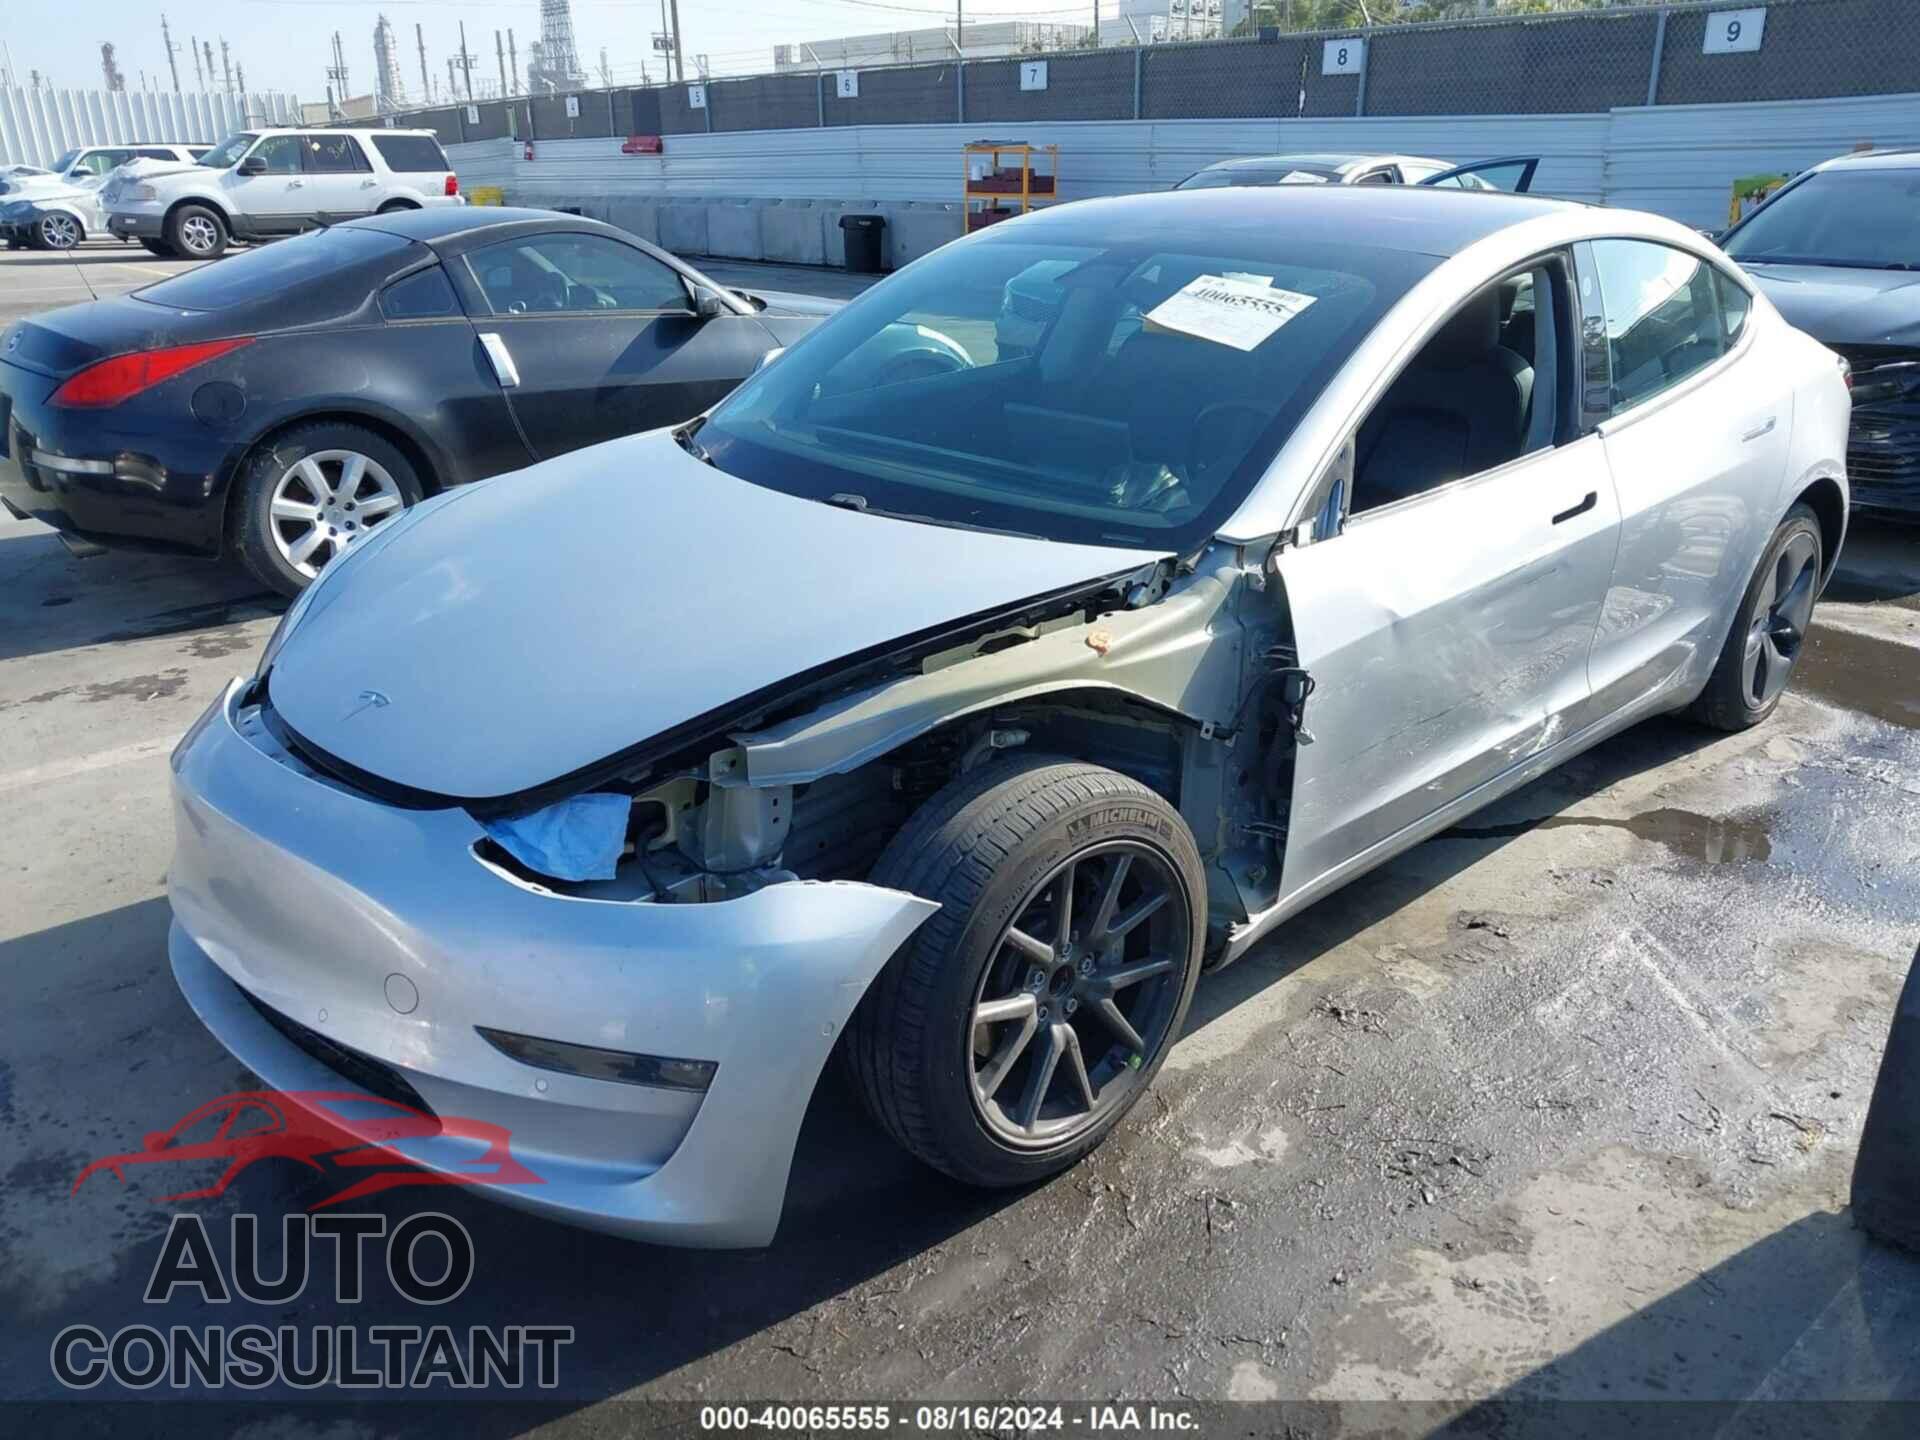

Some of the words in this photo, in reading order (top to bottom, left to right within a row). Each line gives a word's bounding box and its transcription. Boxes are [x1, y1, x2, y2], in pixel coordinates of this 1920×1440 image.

[1727, 21, 1741, 42] 9
[1337, 48, 1348, 66] 8
[1030, 68, 1038, 83] 7
[844, 79, 851, 92] 6
[1089, 808, 1159, 832] MICHELIN
